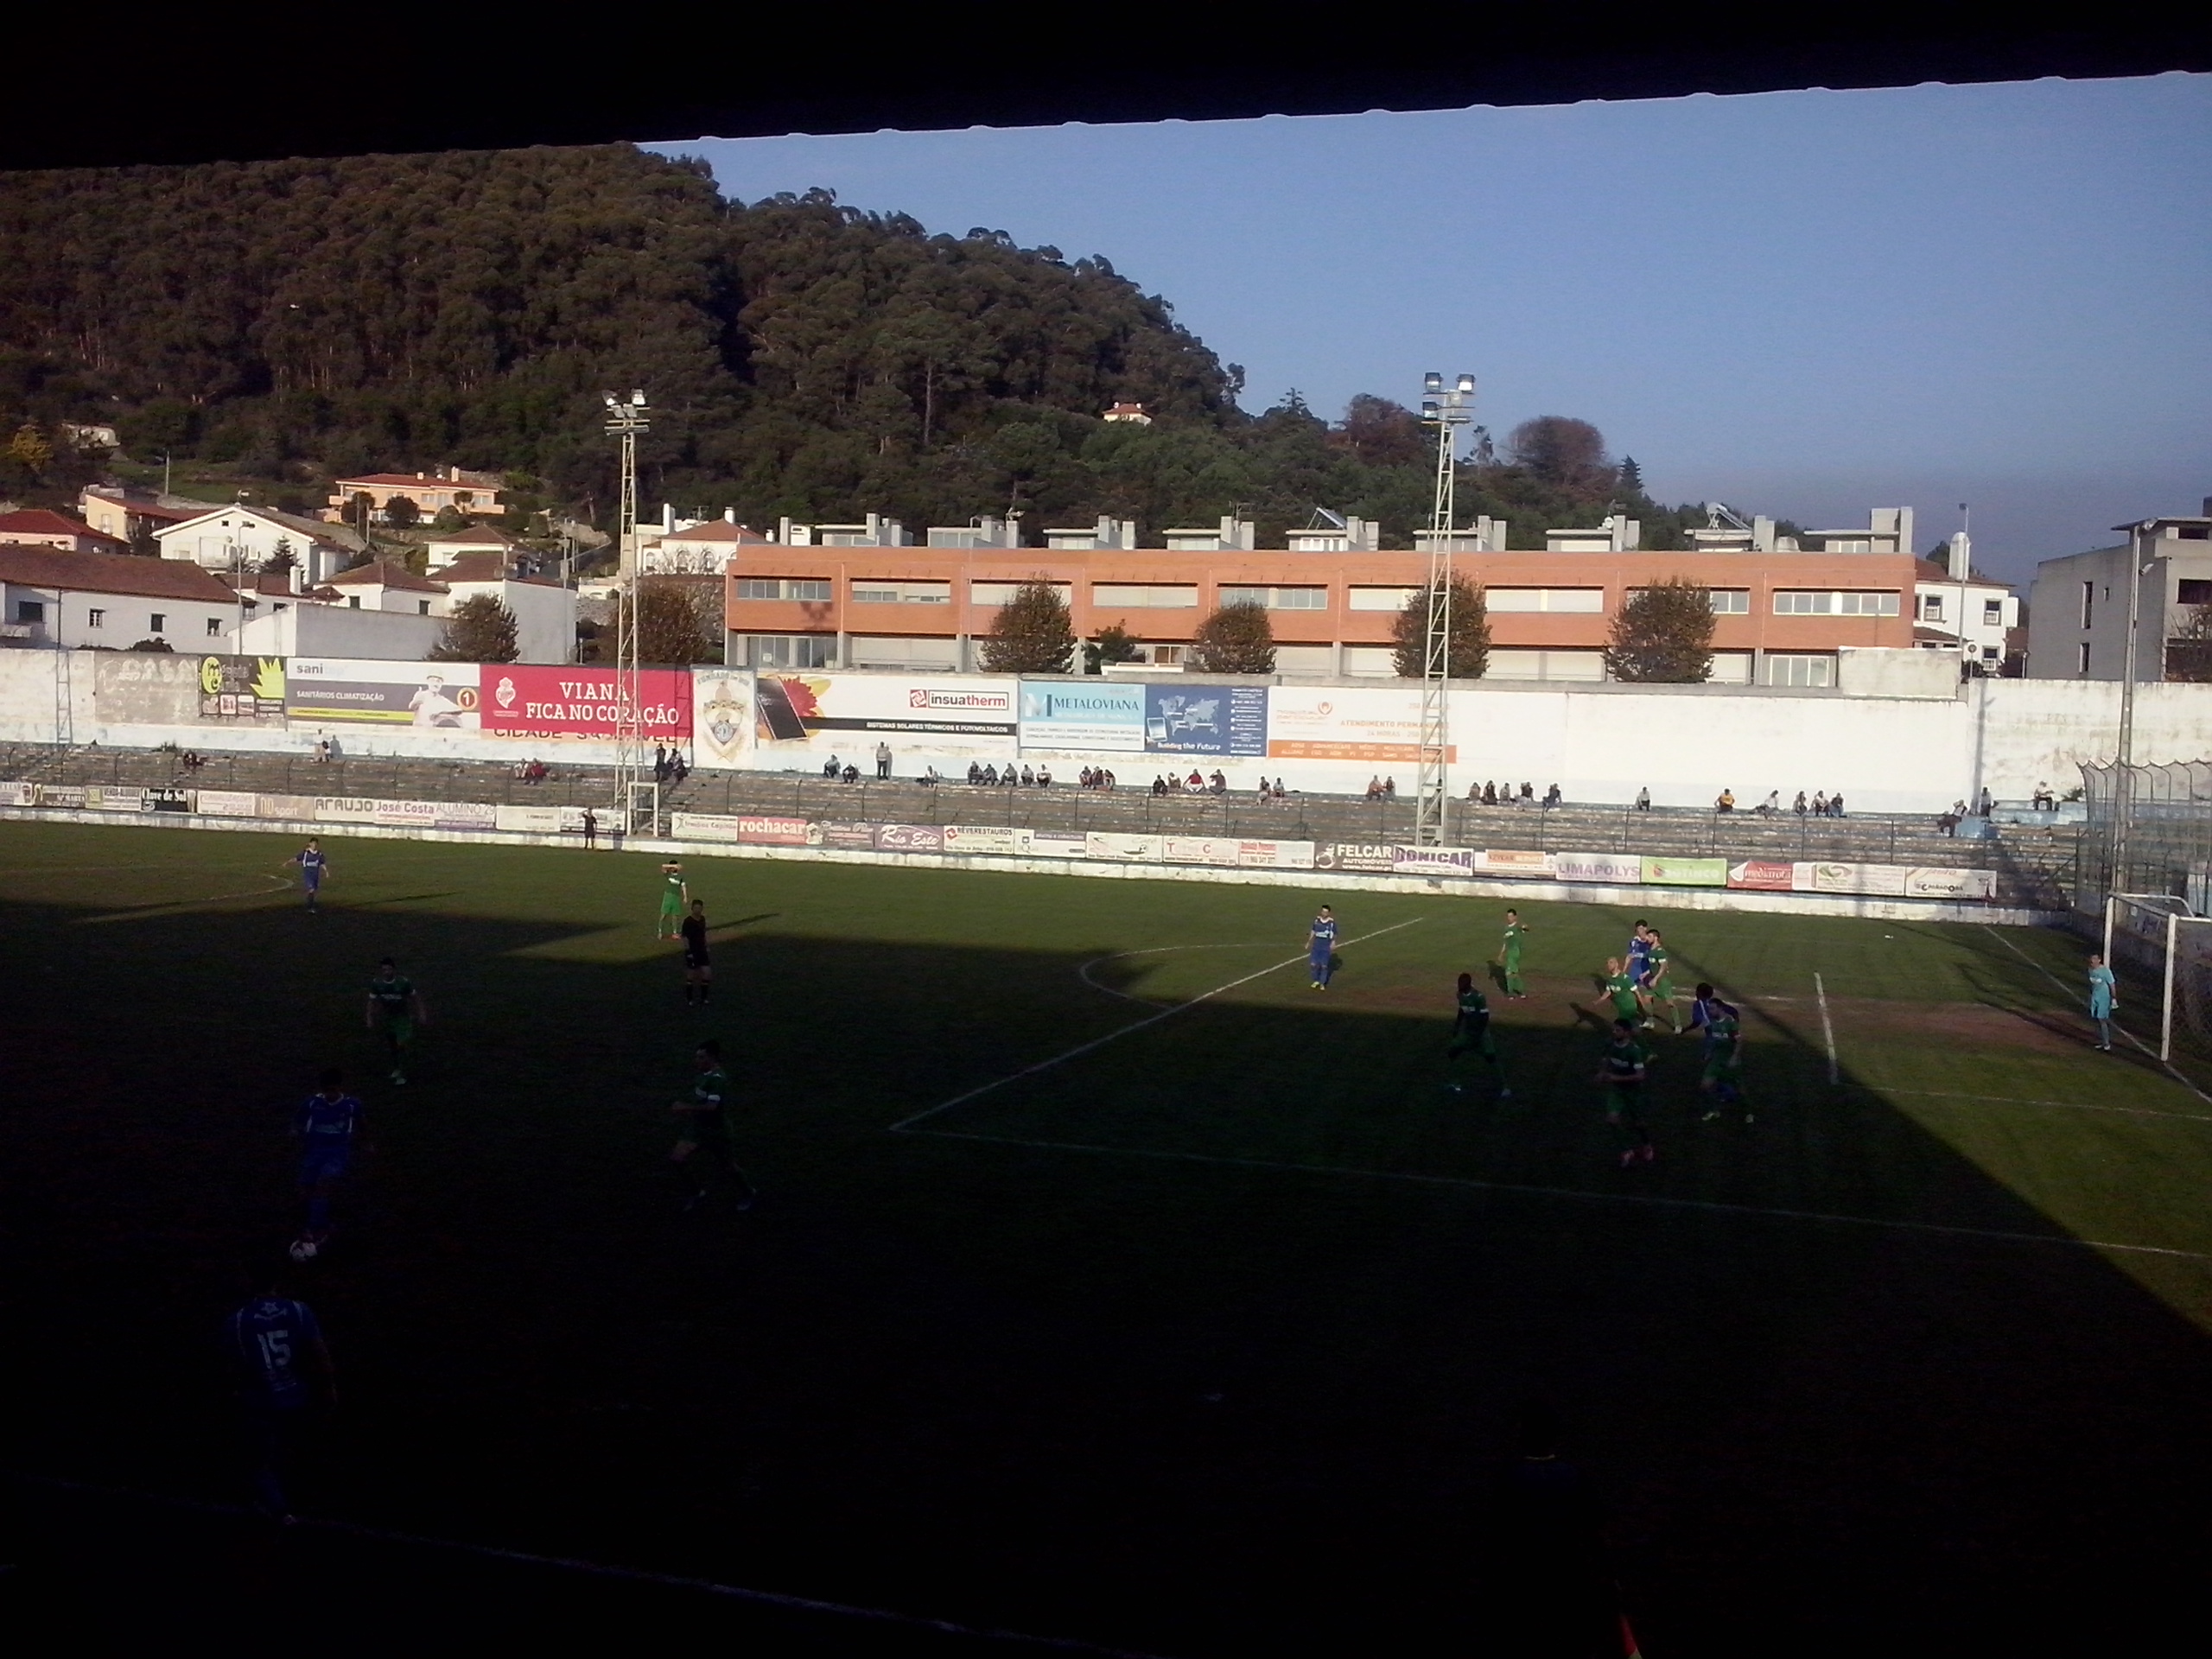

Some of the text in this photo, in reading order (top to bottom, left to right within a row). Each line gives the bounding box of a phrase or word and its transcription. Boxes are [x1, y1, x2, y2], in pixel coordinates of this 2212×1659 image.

[559, 682, 630, 701] VIANA
[931, 693, 1007, 707] insuatherm
[1054, 697, 1140, 710] METALOVIANA
[525, 702, 568, 720] FICA
[569, 703, 594, 721] NO
[376, 800, 435, 814] José Costa
[739, 818, 805, 835] rochacar
[1337, 843, 1393, 858] FELCAR
[1558, 863, 1639, 877] LIMAPOLYS
[257, 1329, 292, 1370] 15
